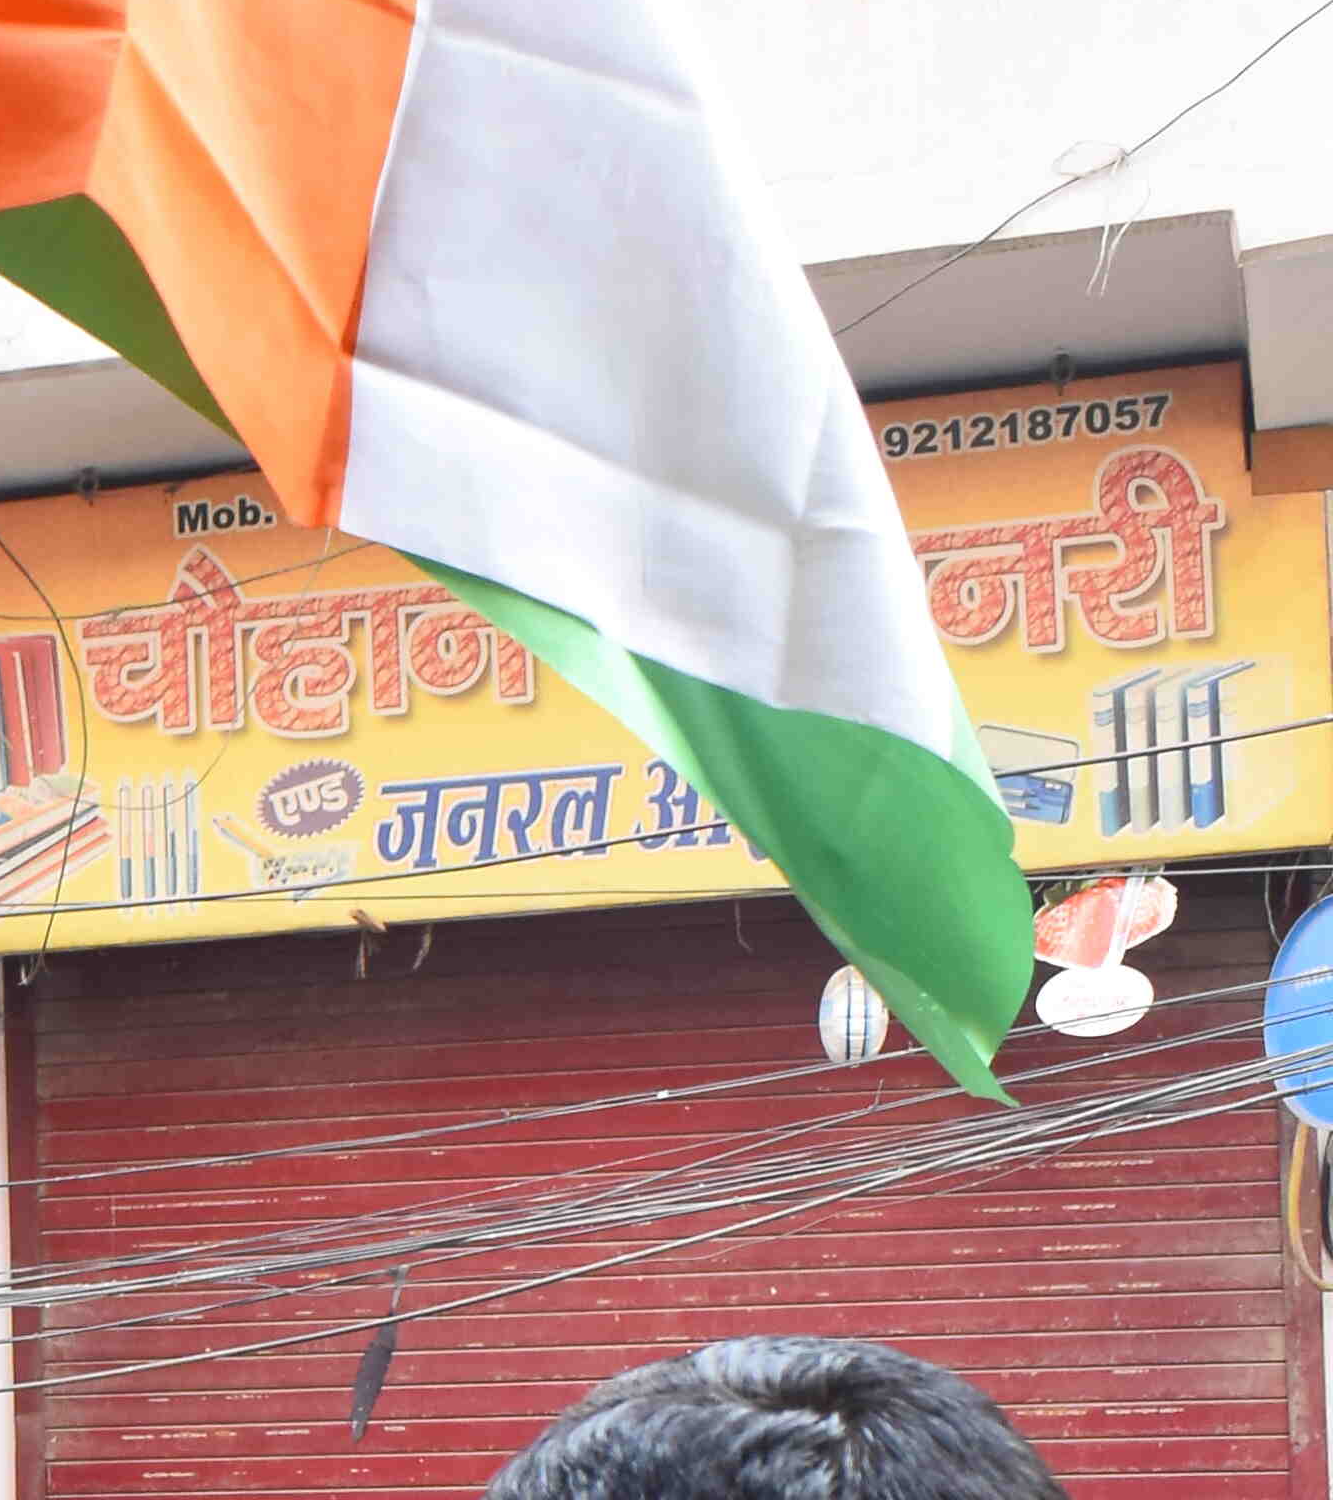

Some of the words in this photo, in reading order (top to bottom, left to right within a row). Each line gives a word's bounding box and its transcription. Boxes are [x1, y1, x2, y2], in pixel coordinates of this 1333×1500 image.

[177, 498, 274, 534] Mob.
[883, 394, 1171, 458] 9212187057
[81, 548, 529, 734] चौहान
[377, 764, 623, 868] जनरल
